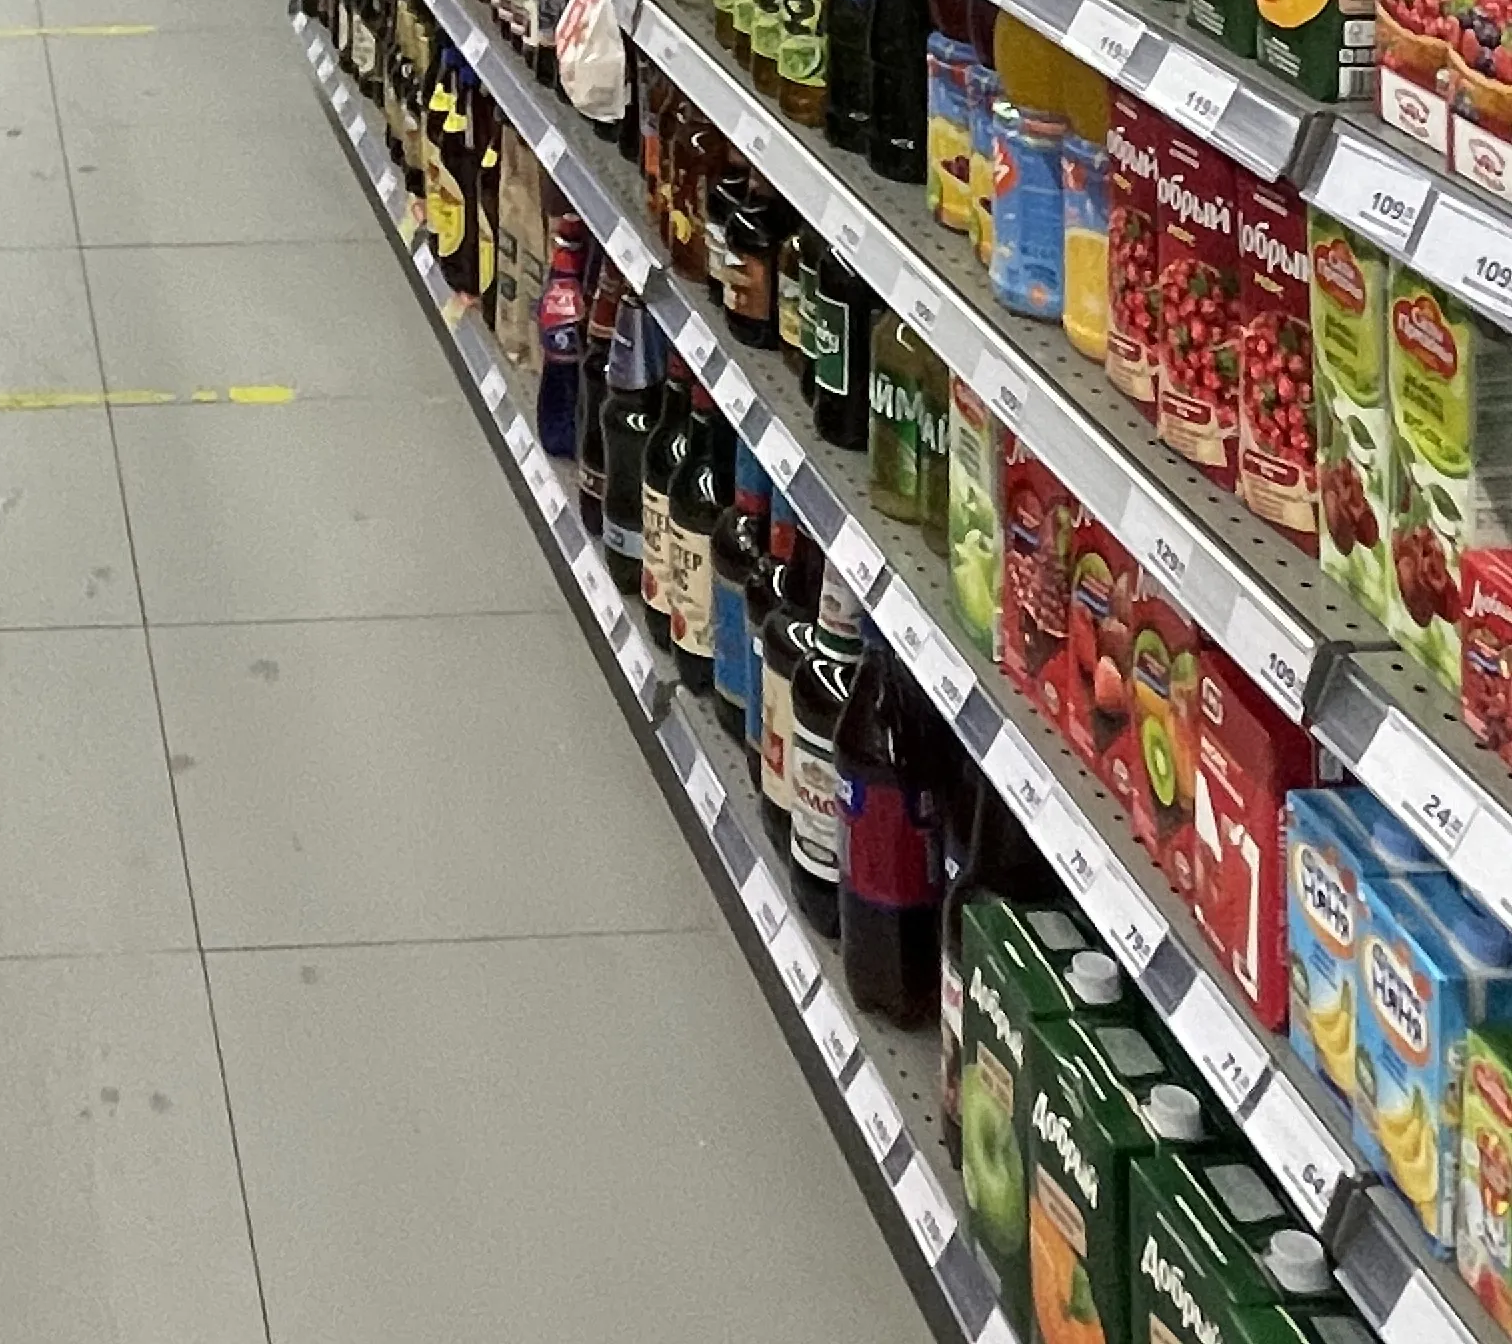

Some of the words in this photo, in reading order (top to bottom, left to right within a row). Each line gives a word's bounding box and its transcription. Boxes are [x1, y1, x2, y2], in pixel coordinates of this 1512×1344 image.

[1187, 90, 1213, 117] 119
[1106, 126, 1159, 182] обрый
[1156, 174, 1232, 235] обрый
[1371, 192, 1405, 220] 109
[1237, 211, 1312, 284] обры
[1475, 256, 1512, 288] 109
[1269, 652, 1297, 689] 109
[1422, 794, 1453, 828] 24
